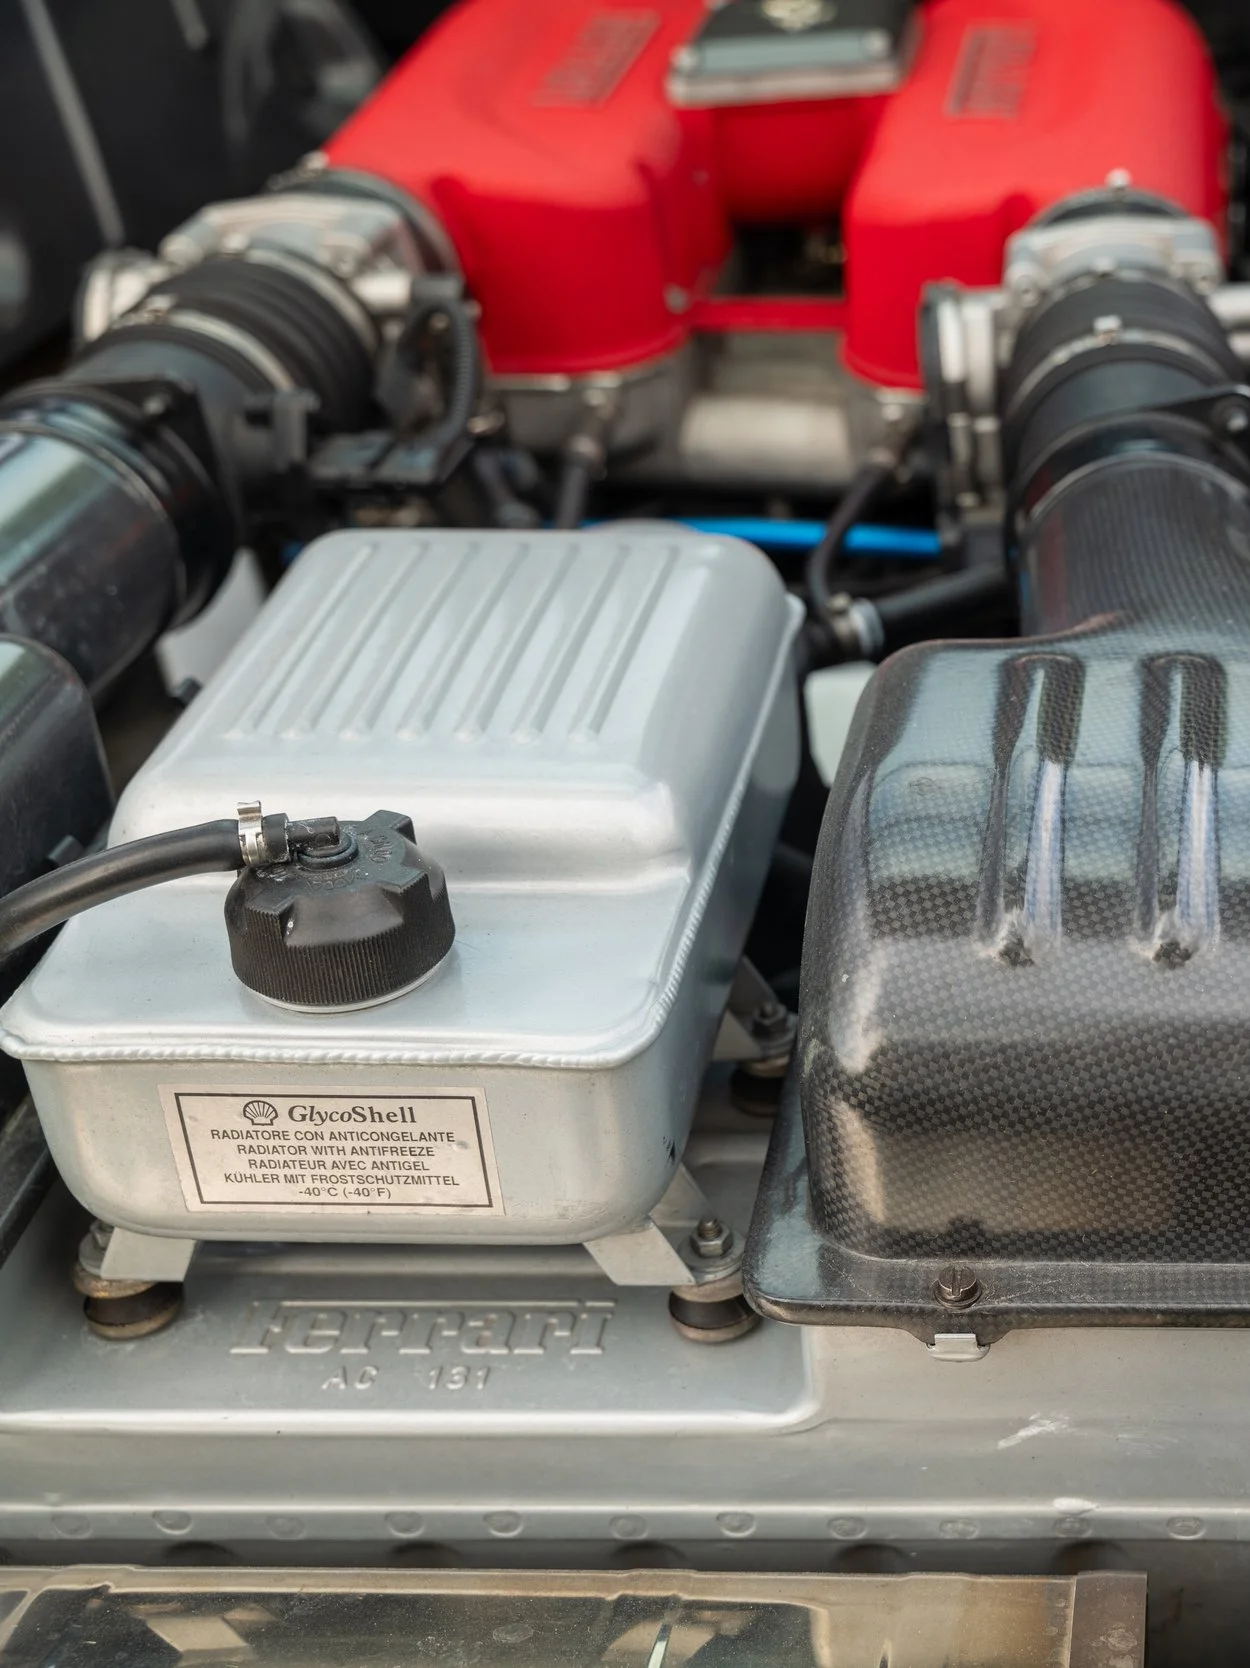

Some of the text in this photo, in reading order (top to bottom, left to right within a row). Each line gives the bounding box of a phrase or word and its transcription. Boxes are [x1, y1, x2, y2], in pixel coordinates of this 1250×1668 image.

[288, 1104, 417, 1127] GlycoShell
[210, 1128, 456, 1143] RADIATORE CON ANTICONGELANTE
[237, 1144, 436, 1157] RADIATOR WITH ANTIFREEZE
[248, 1159, 431, 1171] RADIATEUR AVEC ANTIGEL
[224, 1170, 460, 1186] KÜHLER MIT FROSTSCHUTZMITTEL
[228, 1298, 617, 1355] Ferrari
[321, 1365, 491, 1390] AC 131
